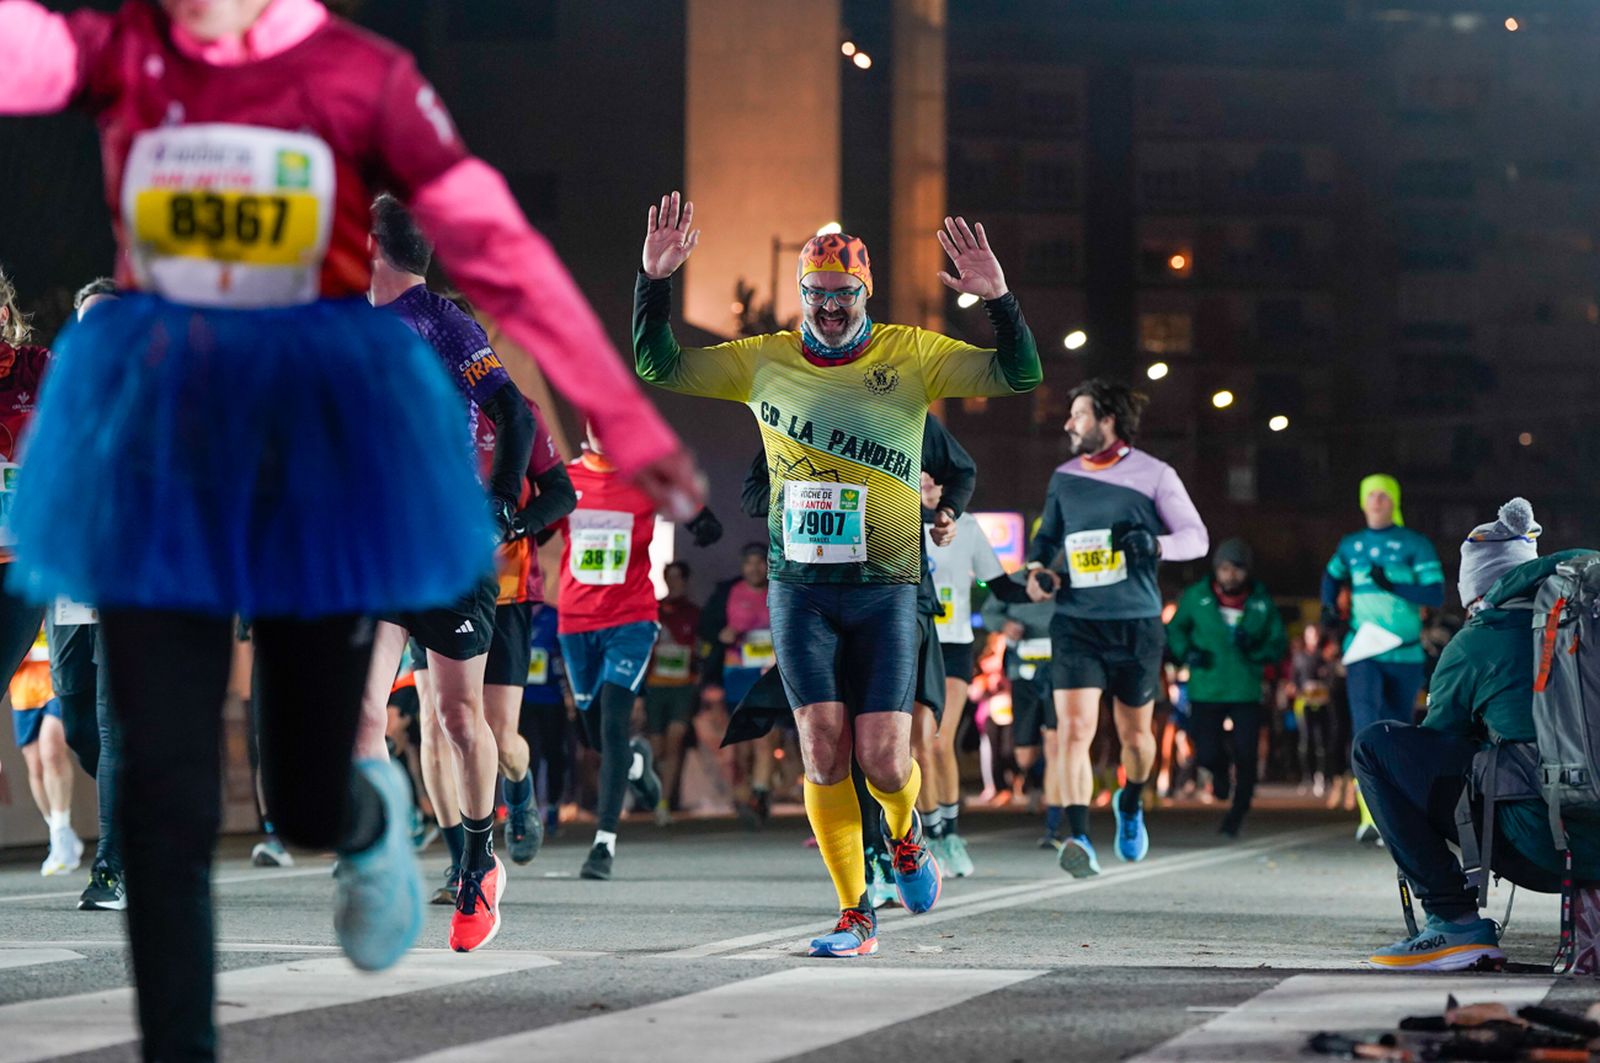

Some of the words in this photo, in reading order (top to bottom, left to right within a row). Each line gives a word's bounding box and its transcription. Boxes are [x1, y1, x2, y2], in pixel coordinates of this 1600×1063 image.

[172, 194, 289, 247] 8367
[788, 415, 813, 444] LA
[828, 429, 912, 481] PANDERA
[822, 491, 832, 499] DE
[1409, 934, 1447, 952] HOKA
